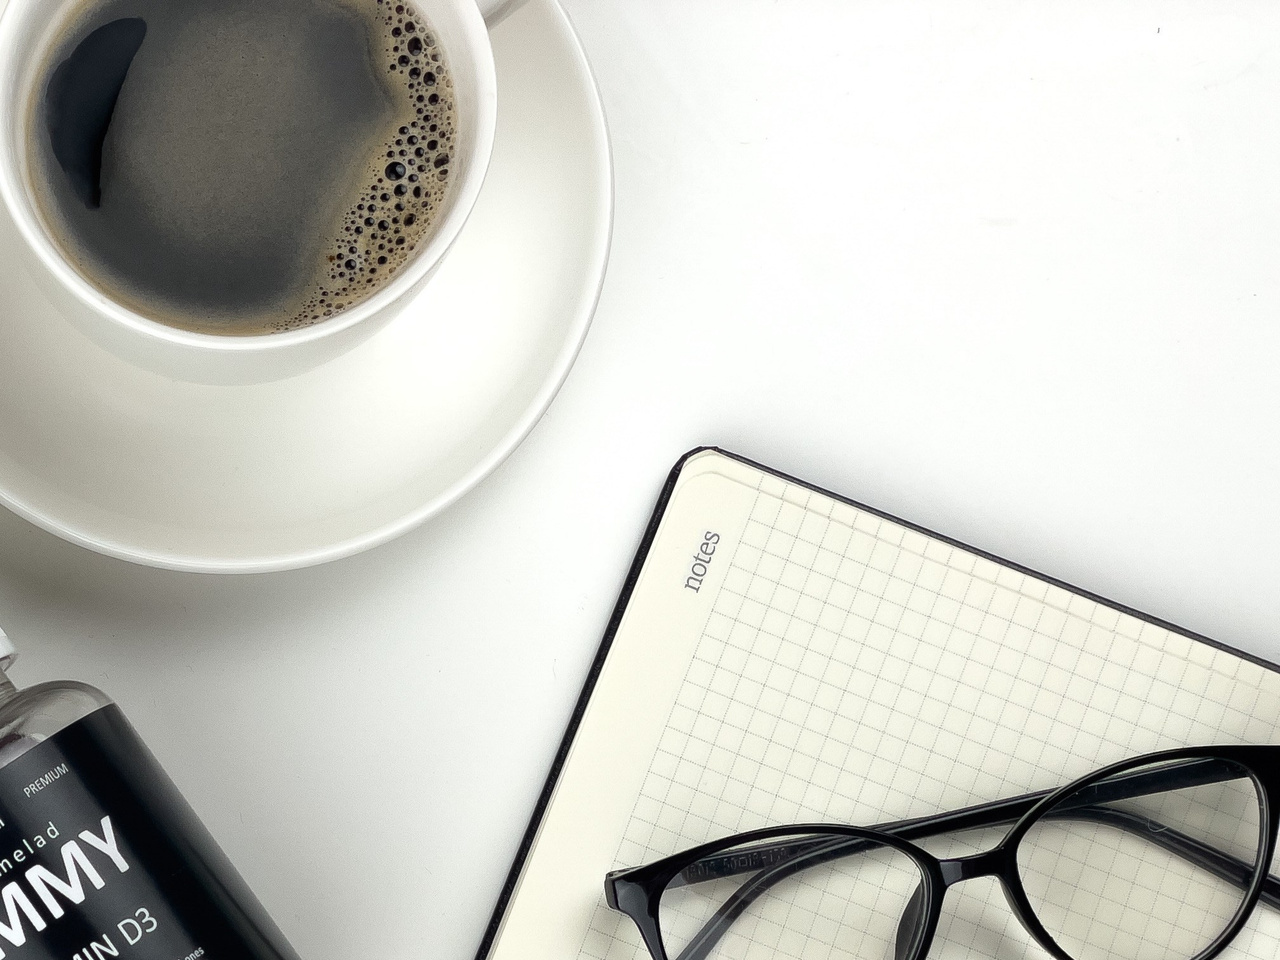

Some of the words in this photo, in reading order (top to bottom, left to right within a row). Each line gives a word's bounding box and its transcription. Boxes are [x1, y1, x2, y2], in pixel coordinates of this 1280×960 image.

[684, 531, 720, 593] notes
[23, 763, 69, 798] PREMIUM
[117, 907, 158, 946] D3
